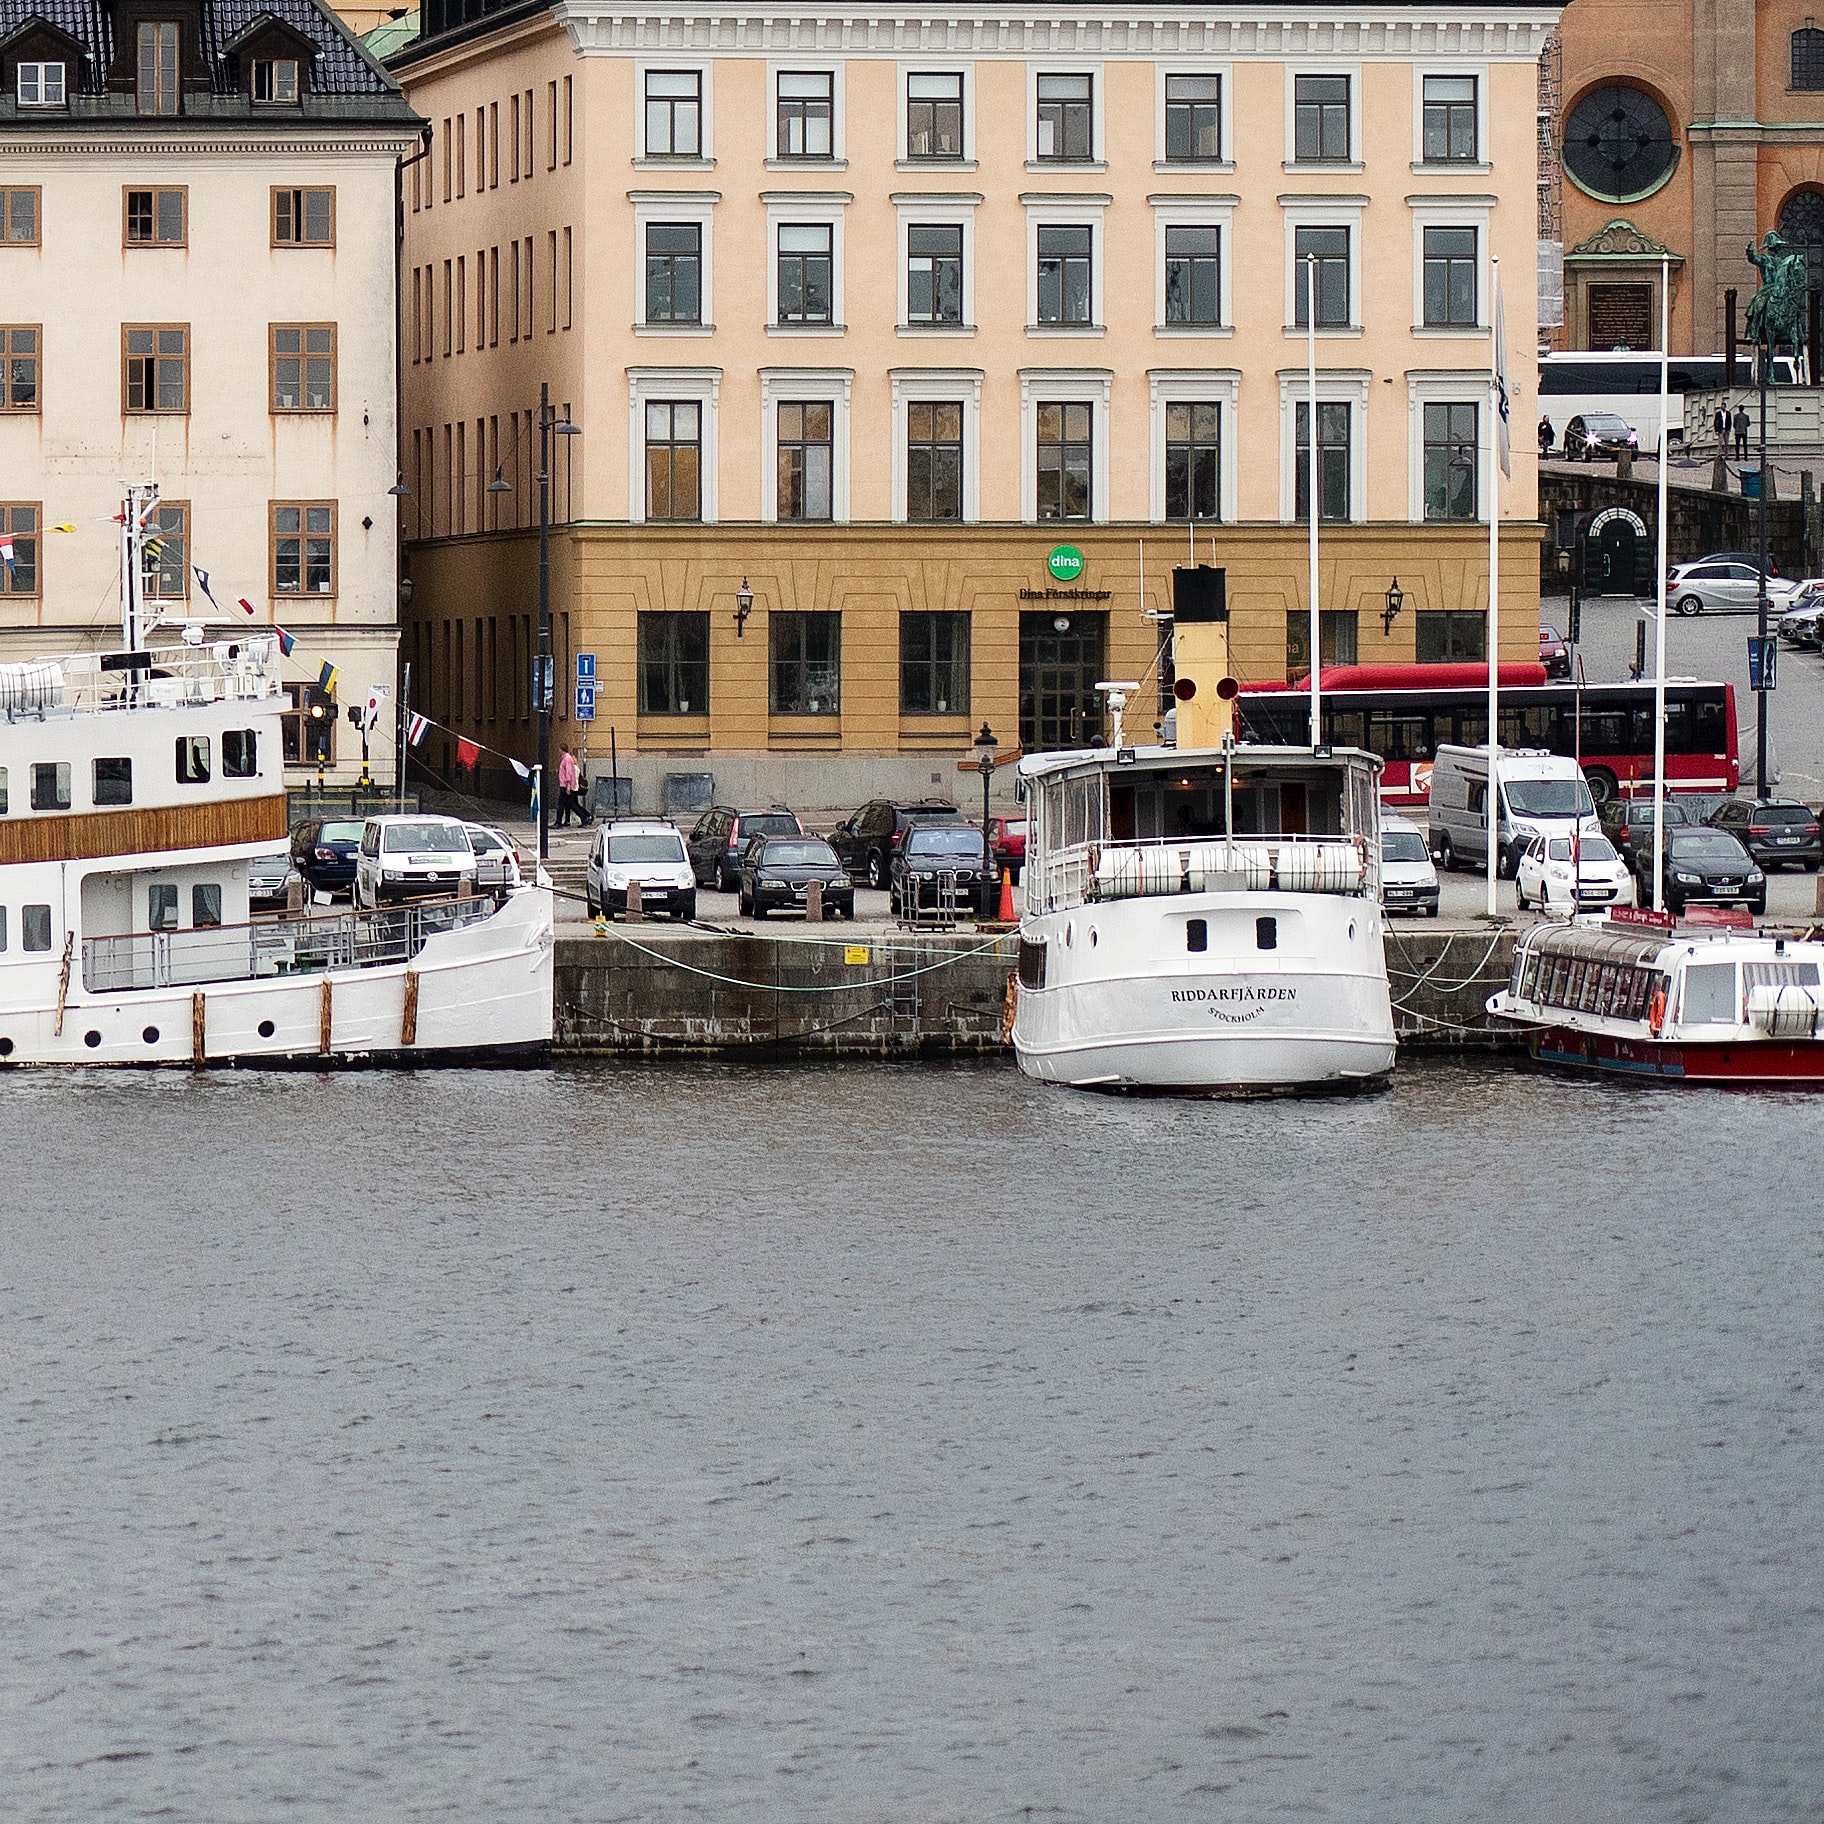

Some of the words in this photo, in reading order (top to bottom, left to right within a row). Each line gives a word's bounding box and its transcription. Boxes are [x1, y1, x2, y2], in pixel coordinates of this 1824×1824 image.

[1051, 554, 1080, 568] dina
[1019, 587, 1044, 600] Dina
[1045, 586, 1112, 603] Försäkringar
[1171, 986, 1297, 1003] RIDDARFJÄRDEN
[1207, 1005, 1265, 1024] STOCKHOLM
